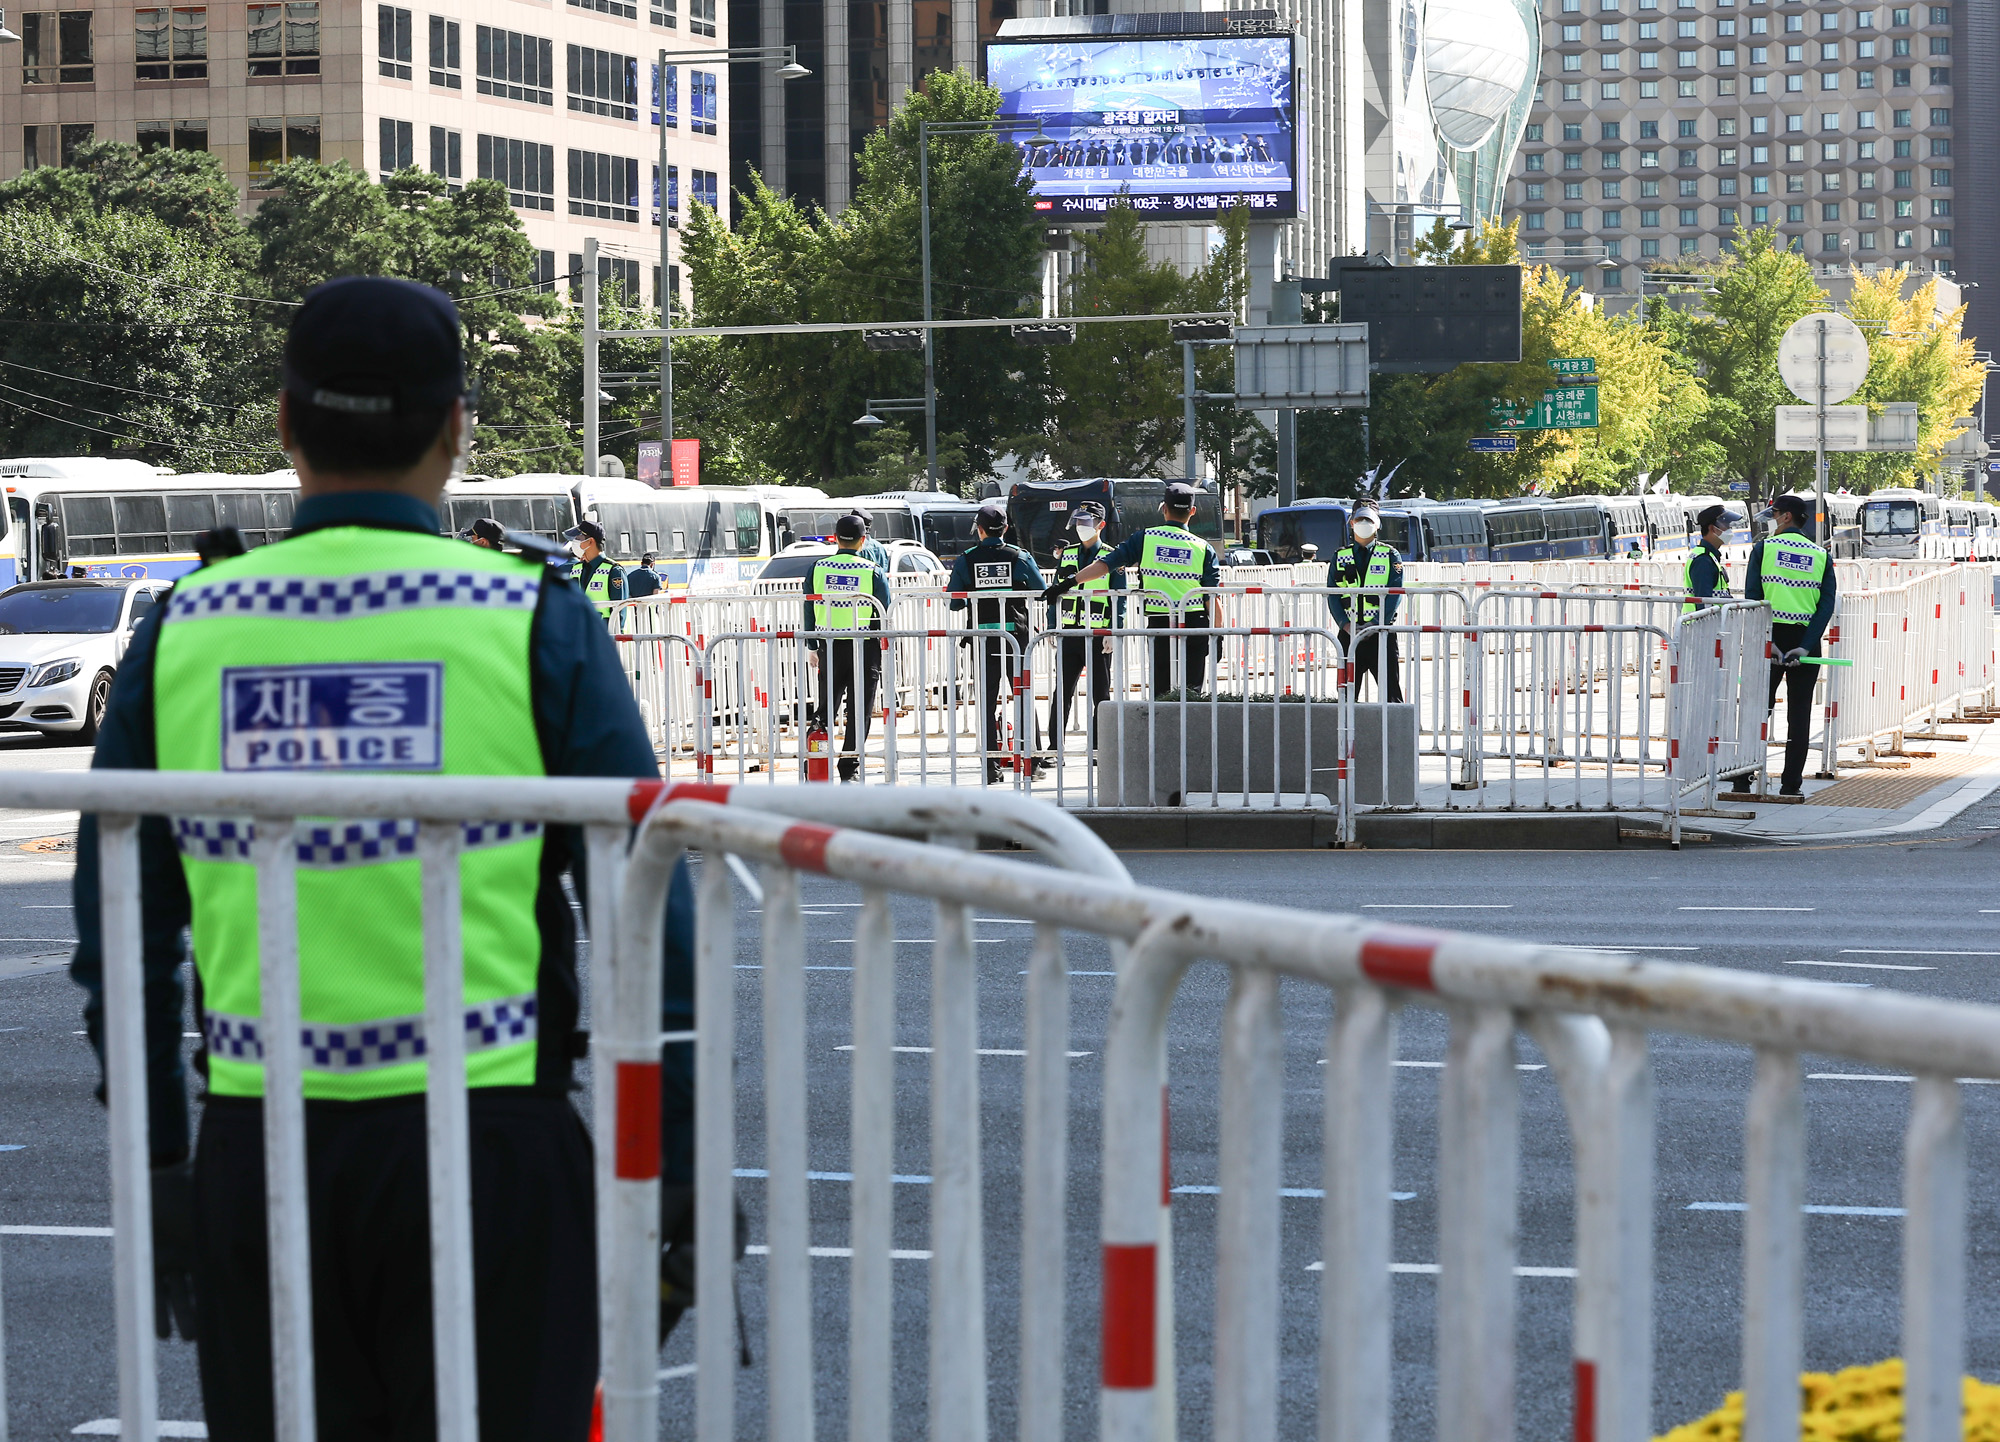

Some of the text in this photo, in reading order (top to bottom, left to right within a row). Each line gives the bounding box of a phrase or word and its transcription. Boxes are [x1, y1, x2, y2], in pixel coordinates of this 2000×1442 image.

[1102, 110, 1179, 125] 광주형 일자리
[1063, 168, 1095, 179] 개척한
[1100, 167, 1110, 179] 길
[1132, 166, 1189, 178] 대한민국을
[1062, 198, 1084, 211] 수시
[1086, 198, 1108, 211] 미달
[1173, 195, 1195, 209] 정시
[1196, 195, 1219, 209] 선발
[1265, 194, 1279, 208] 듯
[1552, 361, 1589, 372] 청계광장
[1555, 389, 1586, 401] 숭례문
[1556, 410, 1576, 421] 시청
[1160, 548, 1189, 558] 경찰
[1781, 552, 1810, 565] 경찰
[1158, 556, 1188, 564] POLICE
[1779, 561, 1809, 570] POLICE
[978, 565, 1008, 577] 경찰
[828, 575, 856, 585] 경찰
[250, 676, 408, 726] 채증
[247, 736, 414, 764] POLICE
